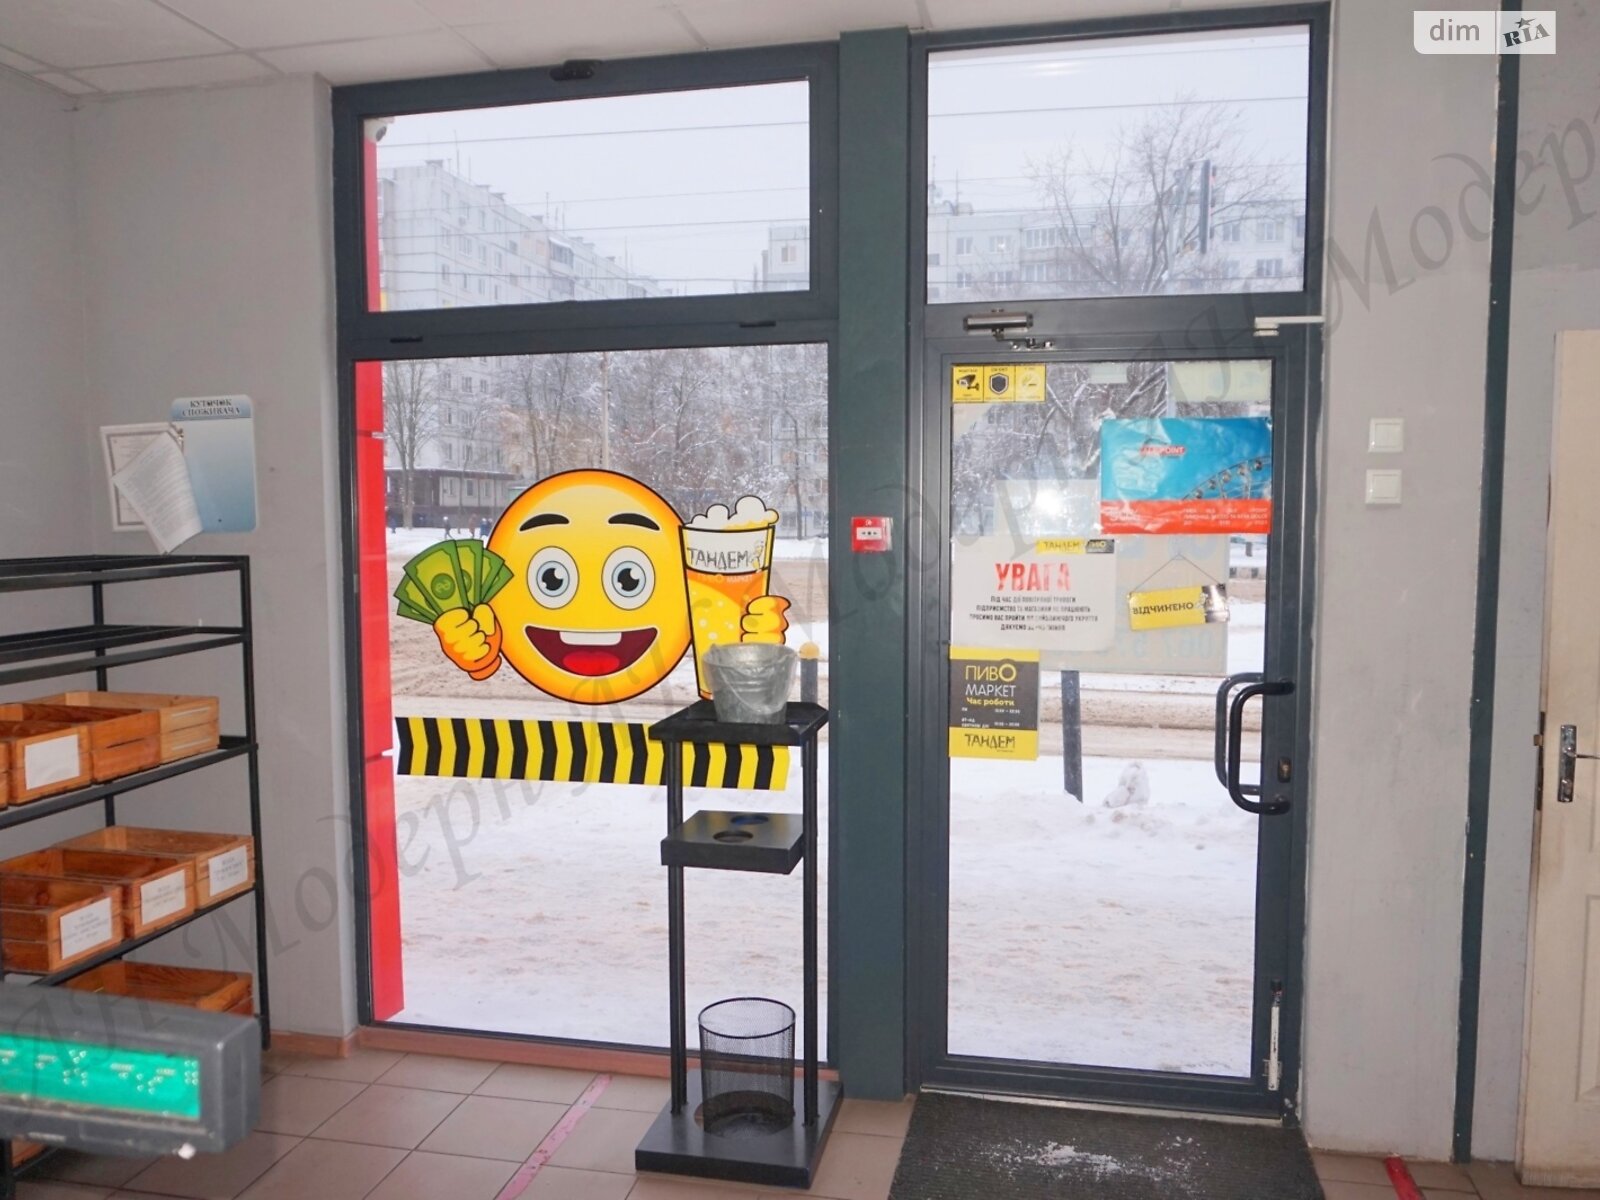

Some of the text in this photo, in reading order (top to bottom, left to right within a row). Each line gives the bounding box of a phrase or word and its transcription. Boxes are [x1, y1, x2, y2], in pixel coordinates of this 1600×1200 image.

[687, 547, 749, 570] ТАНДЕМ
[995, 562, 1071, 591] УВАГА
[1133, 602, 1194, 615] ВІДЧИНЕНО
[965, 663, 1017, 682] ПИВО
[965, 684, 1016, 697] МАРКЕТ
[967, 697, 1015, 707] Час роботи
[965, 733, 1016, 749] ТАНДЕМ
